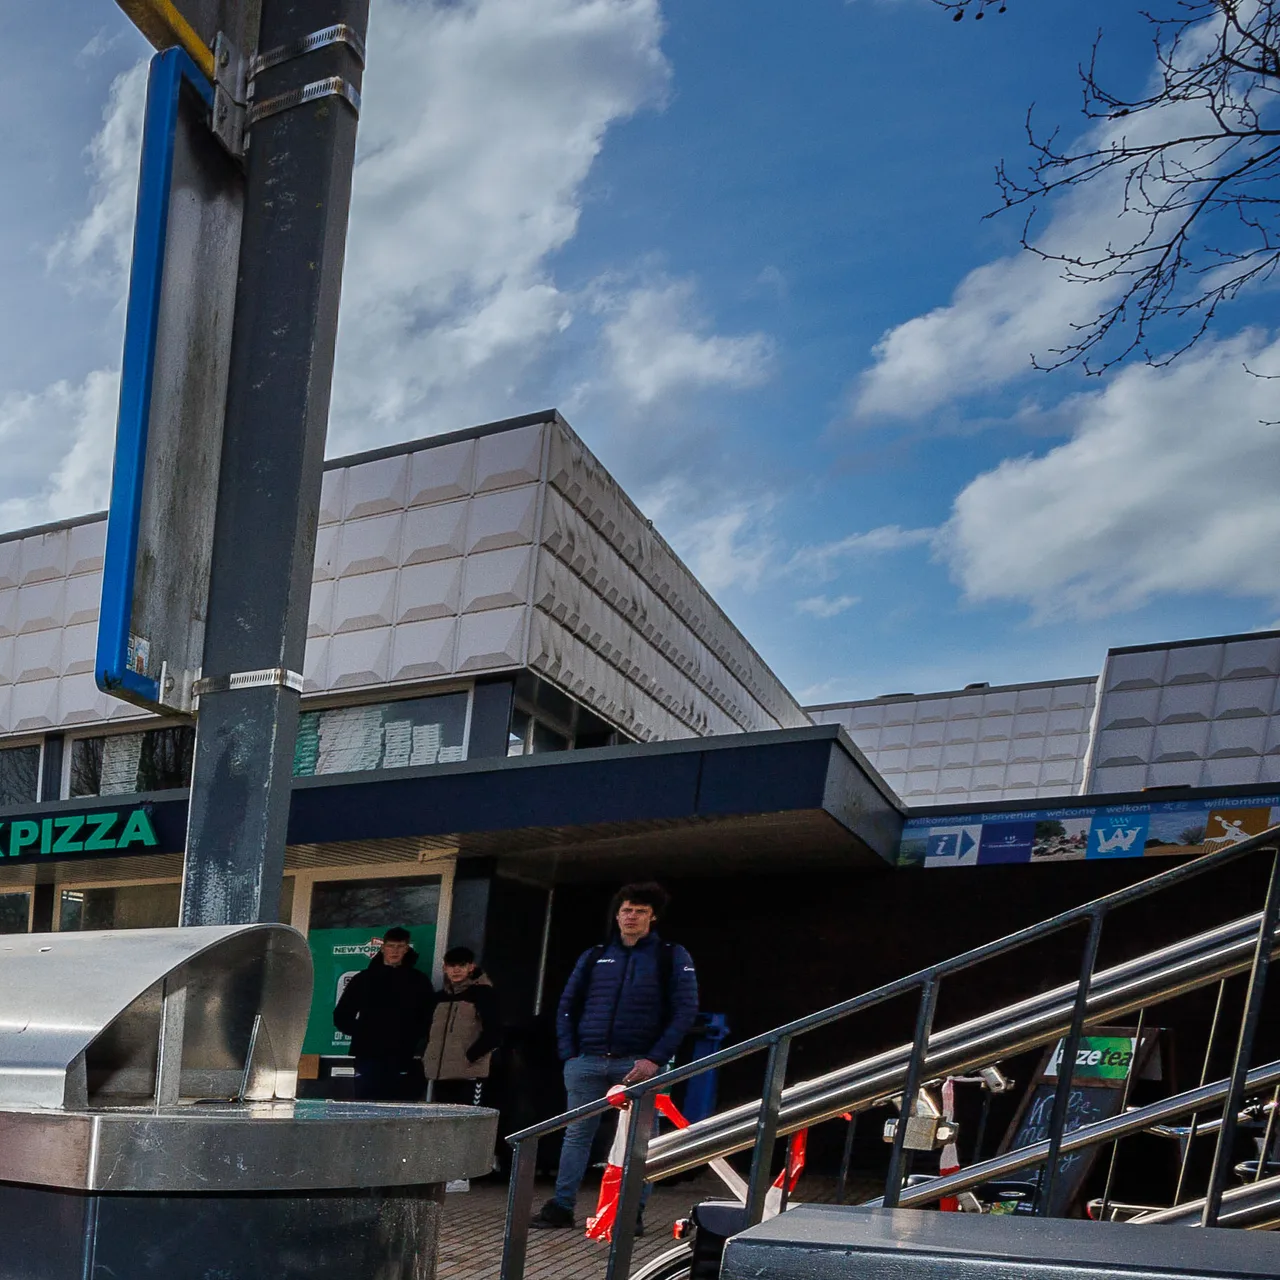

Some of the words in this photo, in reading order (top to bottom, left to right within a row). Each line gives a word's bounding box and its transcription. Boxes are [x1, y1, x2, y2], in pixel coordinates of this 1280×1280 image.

[1204, 797, 1279, 807] willkommen
[1046, 807, 1096, 817] welcome
[1106, 804, 1151, 813] welkom
[981, 811, 1037, 822] bienvenue
[9, 810, 159, 856] PIZZA
